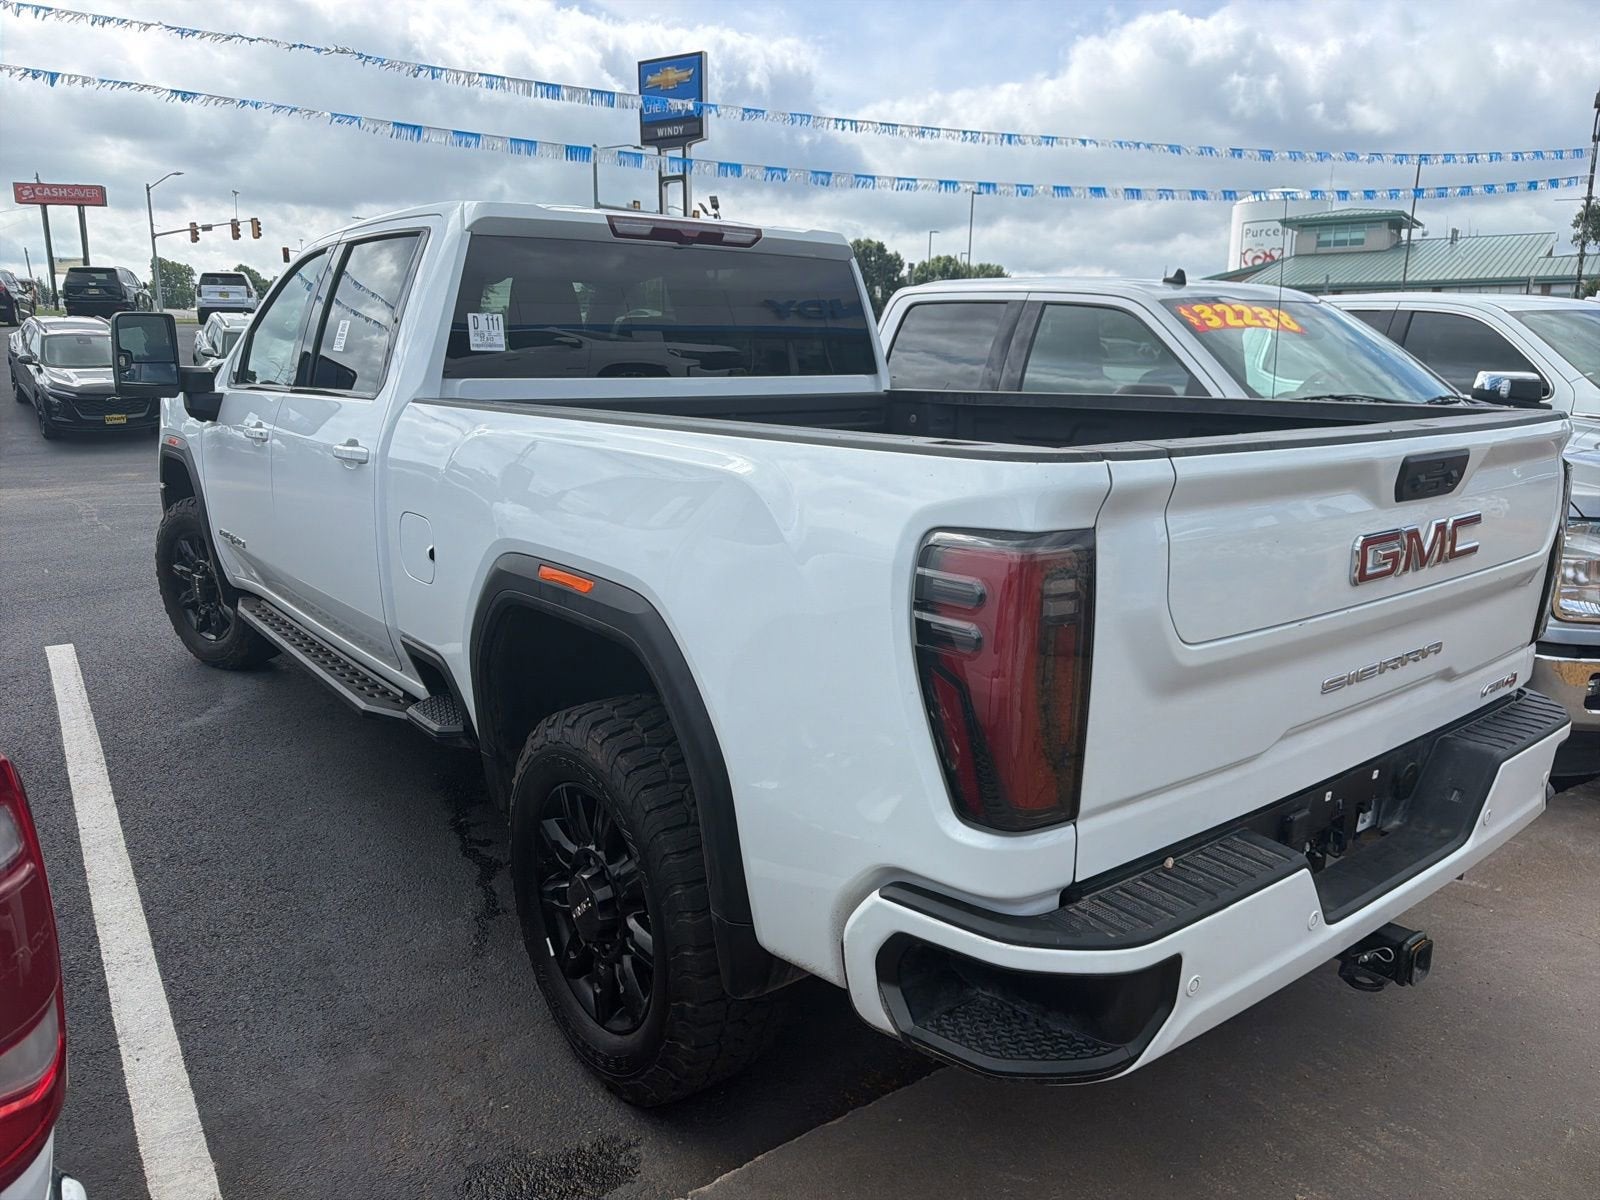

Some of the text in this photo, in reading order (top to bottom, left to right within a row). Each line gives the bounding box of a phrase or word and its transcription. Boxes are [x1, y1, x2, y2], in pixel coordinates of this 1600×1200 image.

[657, 126, 684, 137] WINDY
[473, 314, 500, 331] D 111
[1350, 510, 1482, 586] GMC
[1320, 641, 1443, 695] SIERRA
